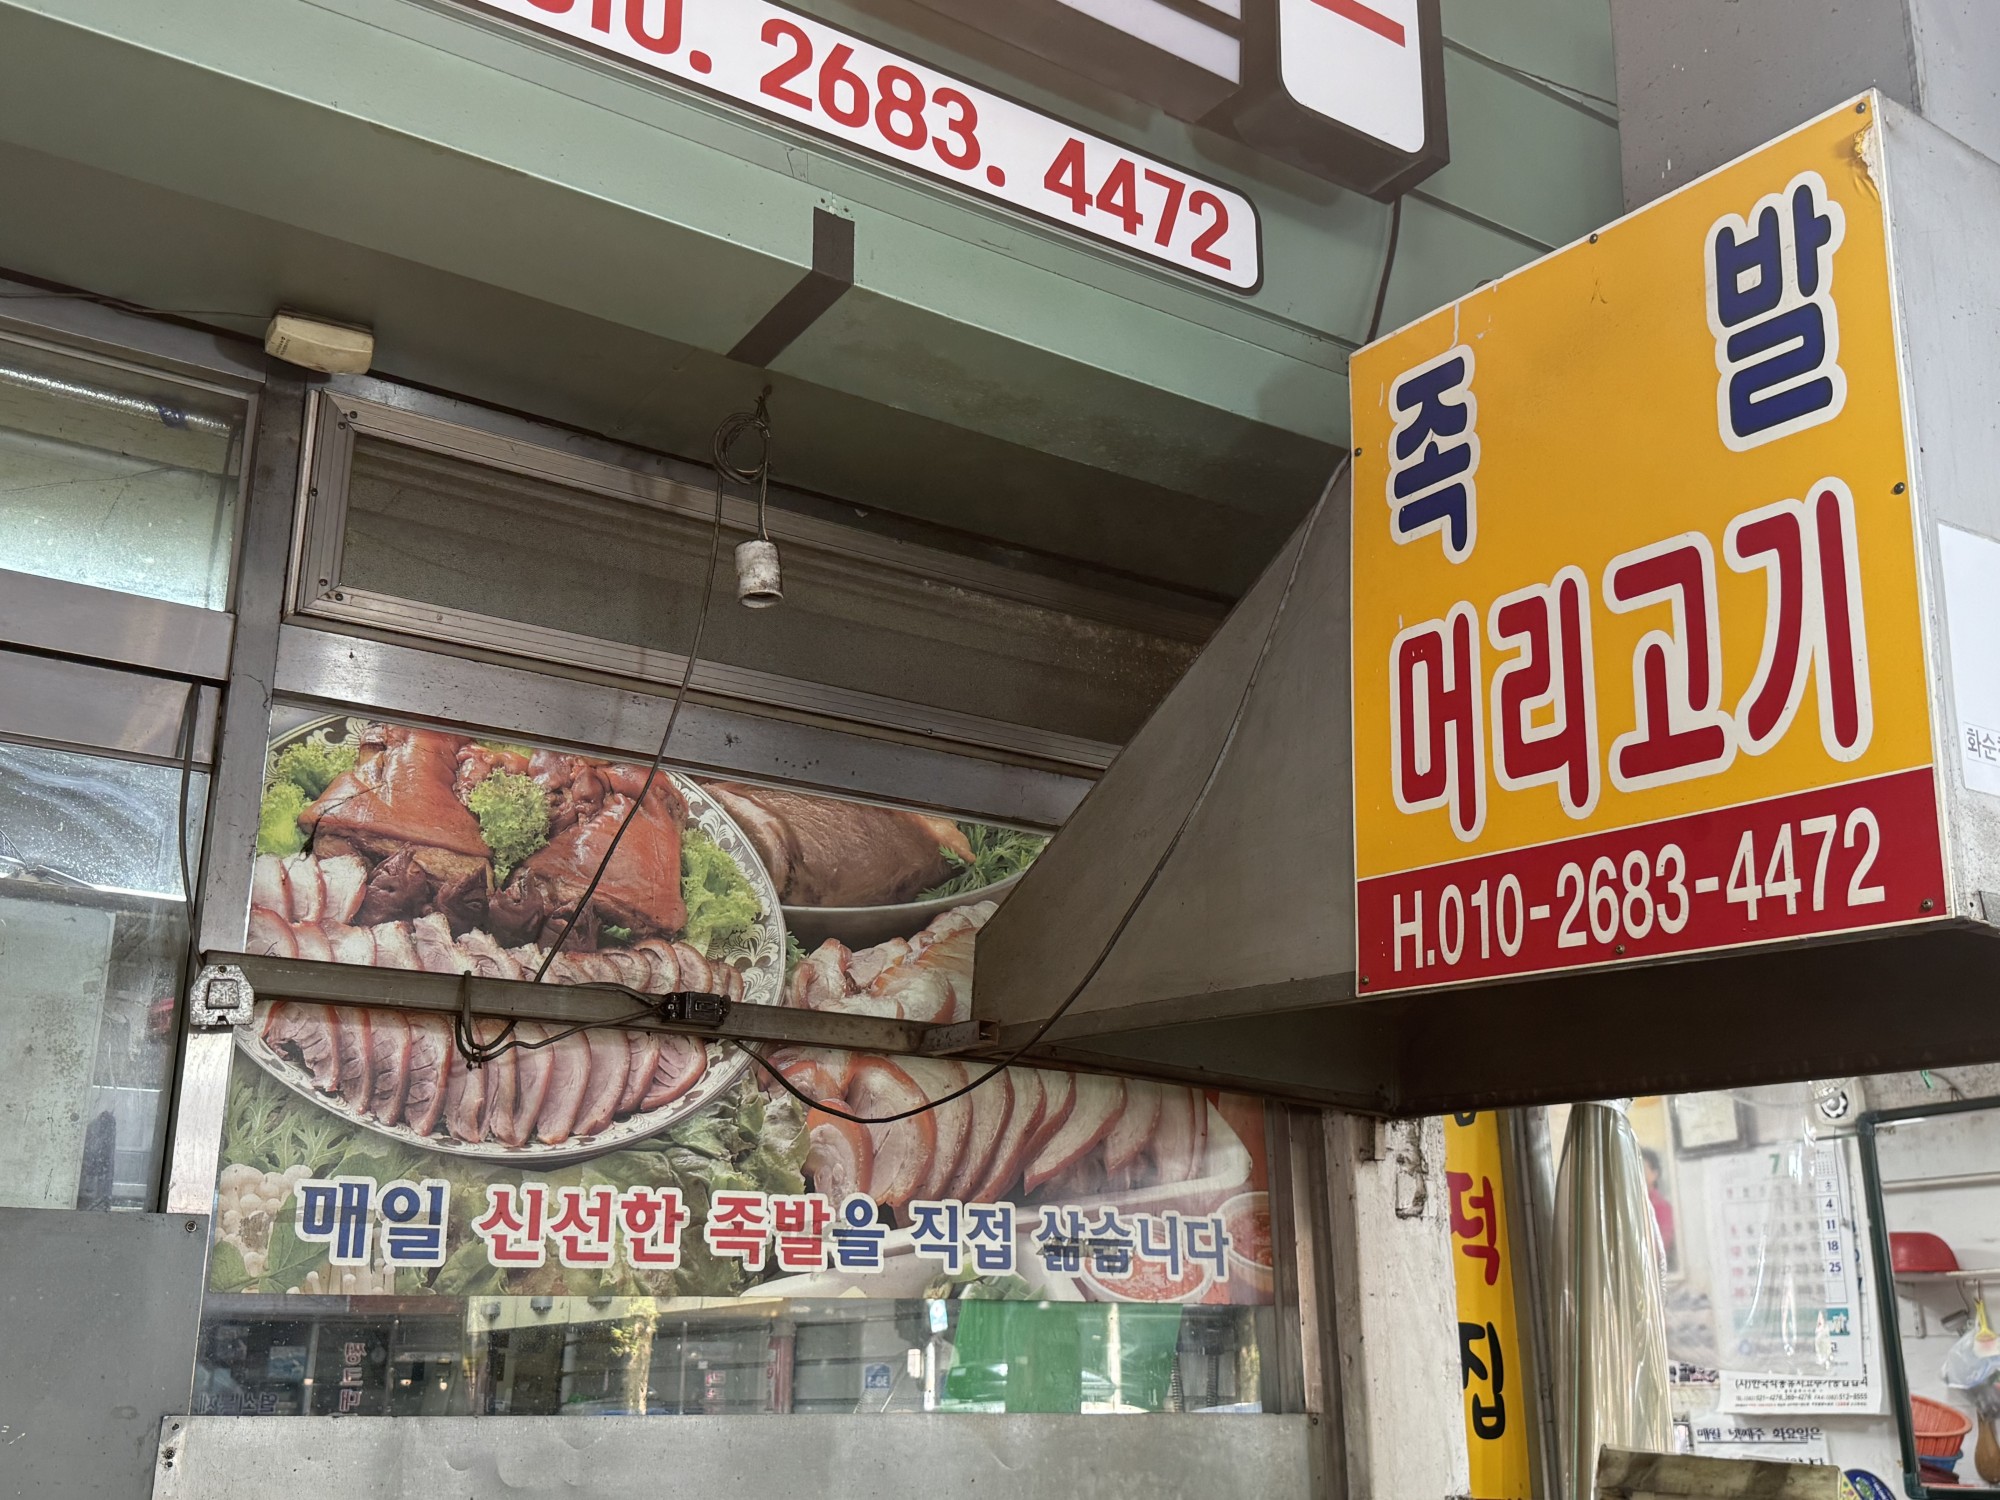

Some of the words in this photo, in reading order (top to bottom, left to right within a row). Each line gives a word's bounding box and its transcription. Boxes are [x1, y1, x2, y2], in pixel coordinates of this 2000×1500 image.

[526, 0, 713, 75] 0.
[759, 18, 1007, 188] 2683.
[1043, 138, 1233, 271] 4472
[1394, 484, 1866, 837] 머리고기
[1965, 727, 2000, 762] 화순
[1392, 807, 1886, 973] H.010-2683-4472
[1825, 1198, 1833, 1209] 4
[298, 1180, 446, 1262] 매일
[477, 1186, 687, 1265] 신선한
[708, 1194, 886, 1269] 족발을
[909, 1203, 1016, 1272] 직접
[1035, 1209, 1231, 1279] 삶습니다
[1826, 1219, 1837, 1230] 11
[1827, 1241, 1839, 1252] 18
[1829, 1262, 1842, 1273] 25
